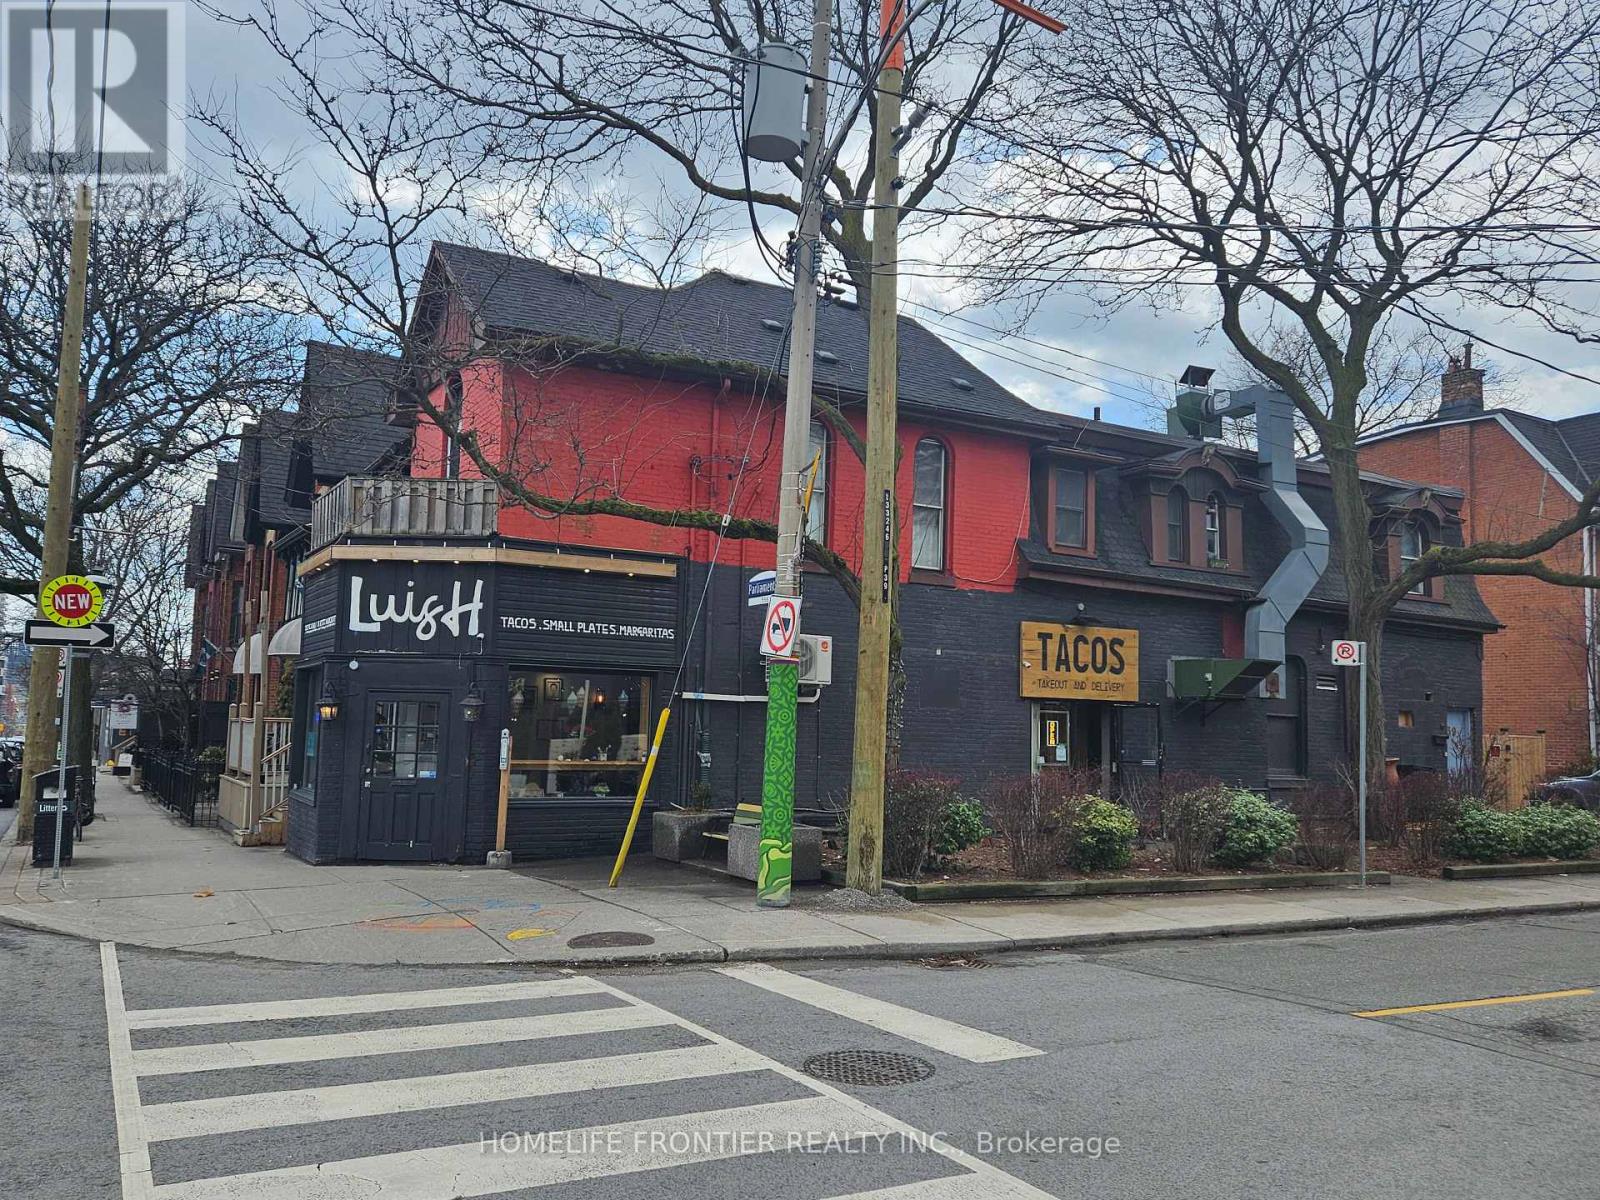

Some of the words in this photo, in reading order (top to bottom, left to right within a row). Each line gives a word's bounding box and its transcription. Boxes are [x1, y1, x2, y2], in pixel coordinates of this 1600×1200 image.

[54, 593, 90, 610] NEW
[1037, 632, 1126, 675] TACOS
[1037, 678, 1068, 690] TAKEOUT
[1073, 681, 1087, 691] AND
[1091, 682, 1125, 693] DELIVERY
[39, 804, 58, 813] Litter
